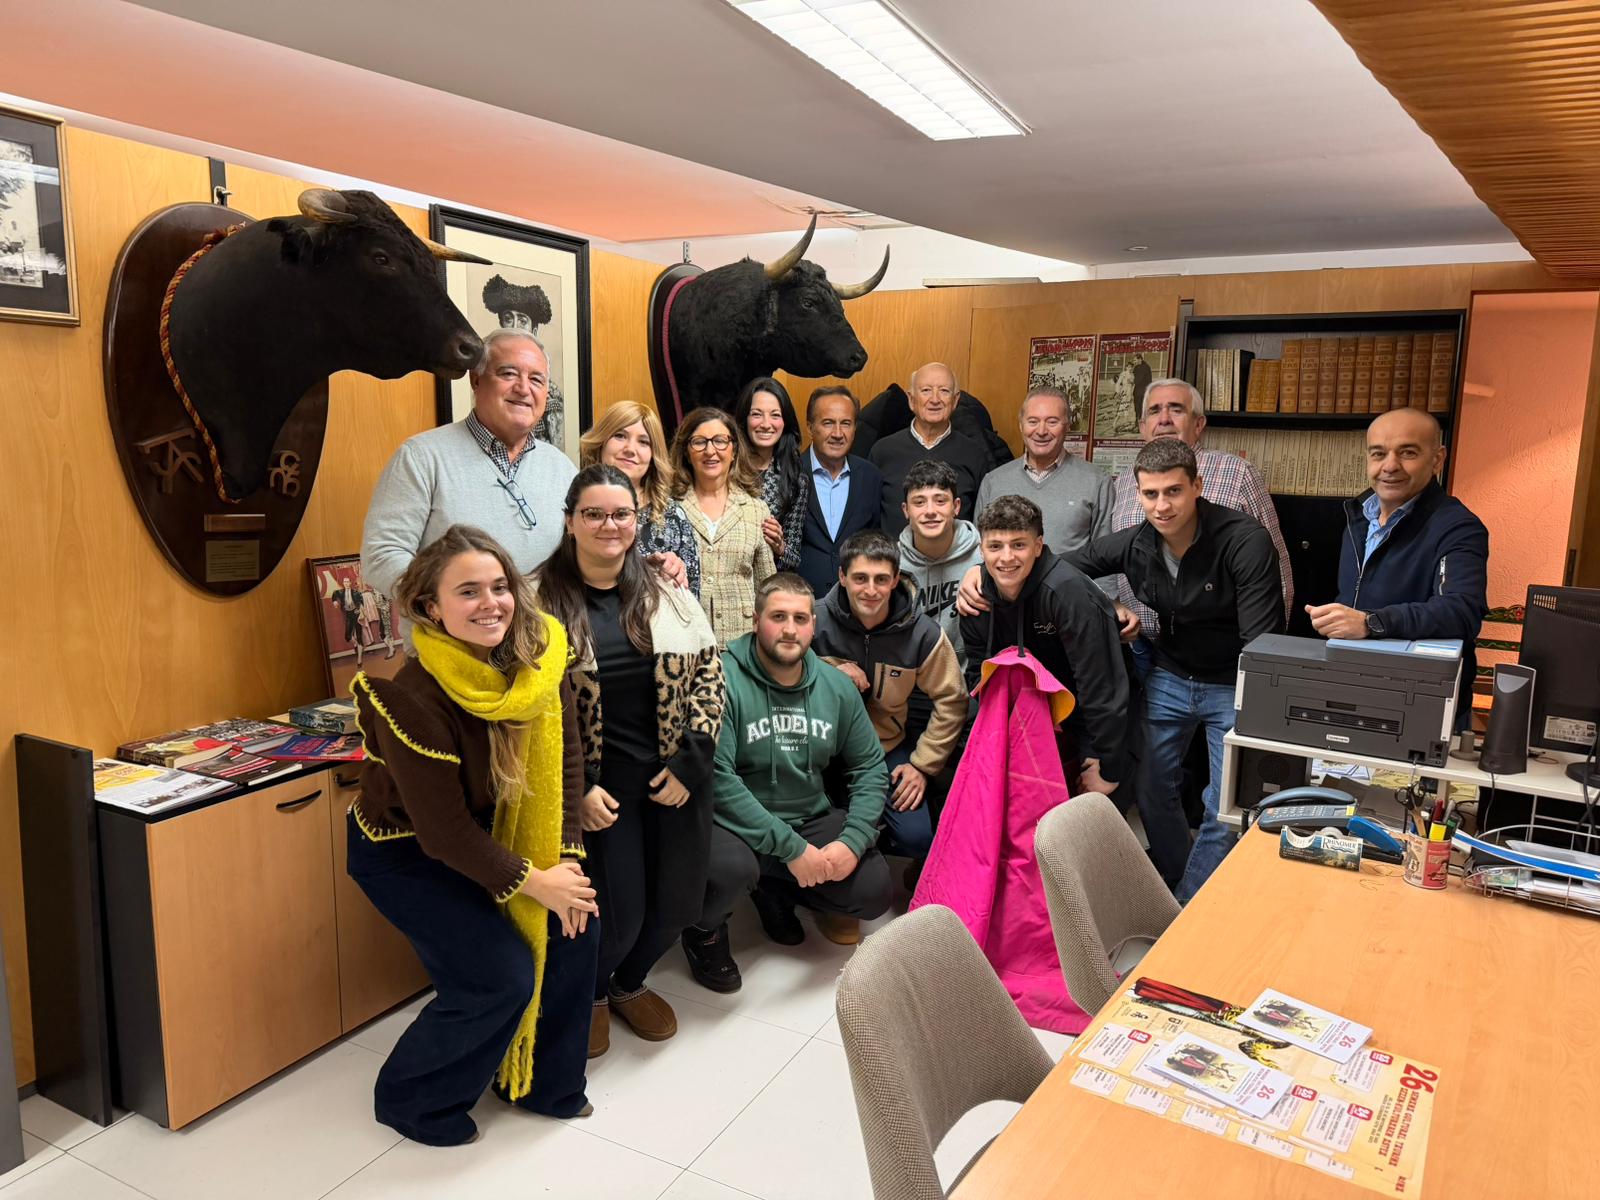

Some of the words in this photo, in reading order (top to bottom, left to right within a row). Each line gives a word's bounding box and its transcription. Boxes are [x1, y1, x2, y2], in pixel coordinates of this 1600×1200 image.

[917, 580, 960, 606] NIKE
[746, 714, 832, 745] ACADEMY
[1323, 838, 1356, 849] RHINOMER
[1339, 1035, 1356, 1048] 26
[1400, 1063, 1438, 1094] 26
[1257, 1085, 1275, 1099] 26
[1406, 1091, 1419, 1113] SEMANA
[1397, 1112, 1412, 1140] CULTURAL
[1379, 1138, 1391, 1157] ASTEA
[1389, 1141, 1404, 1167] TAURINA
